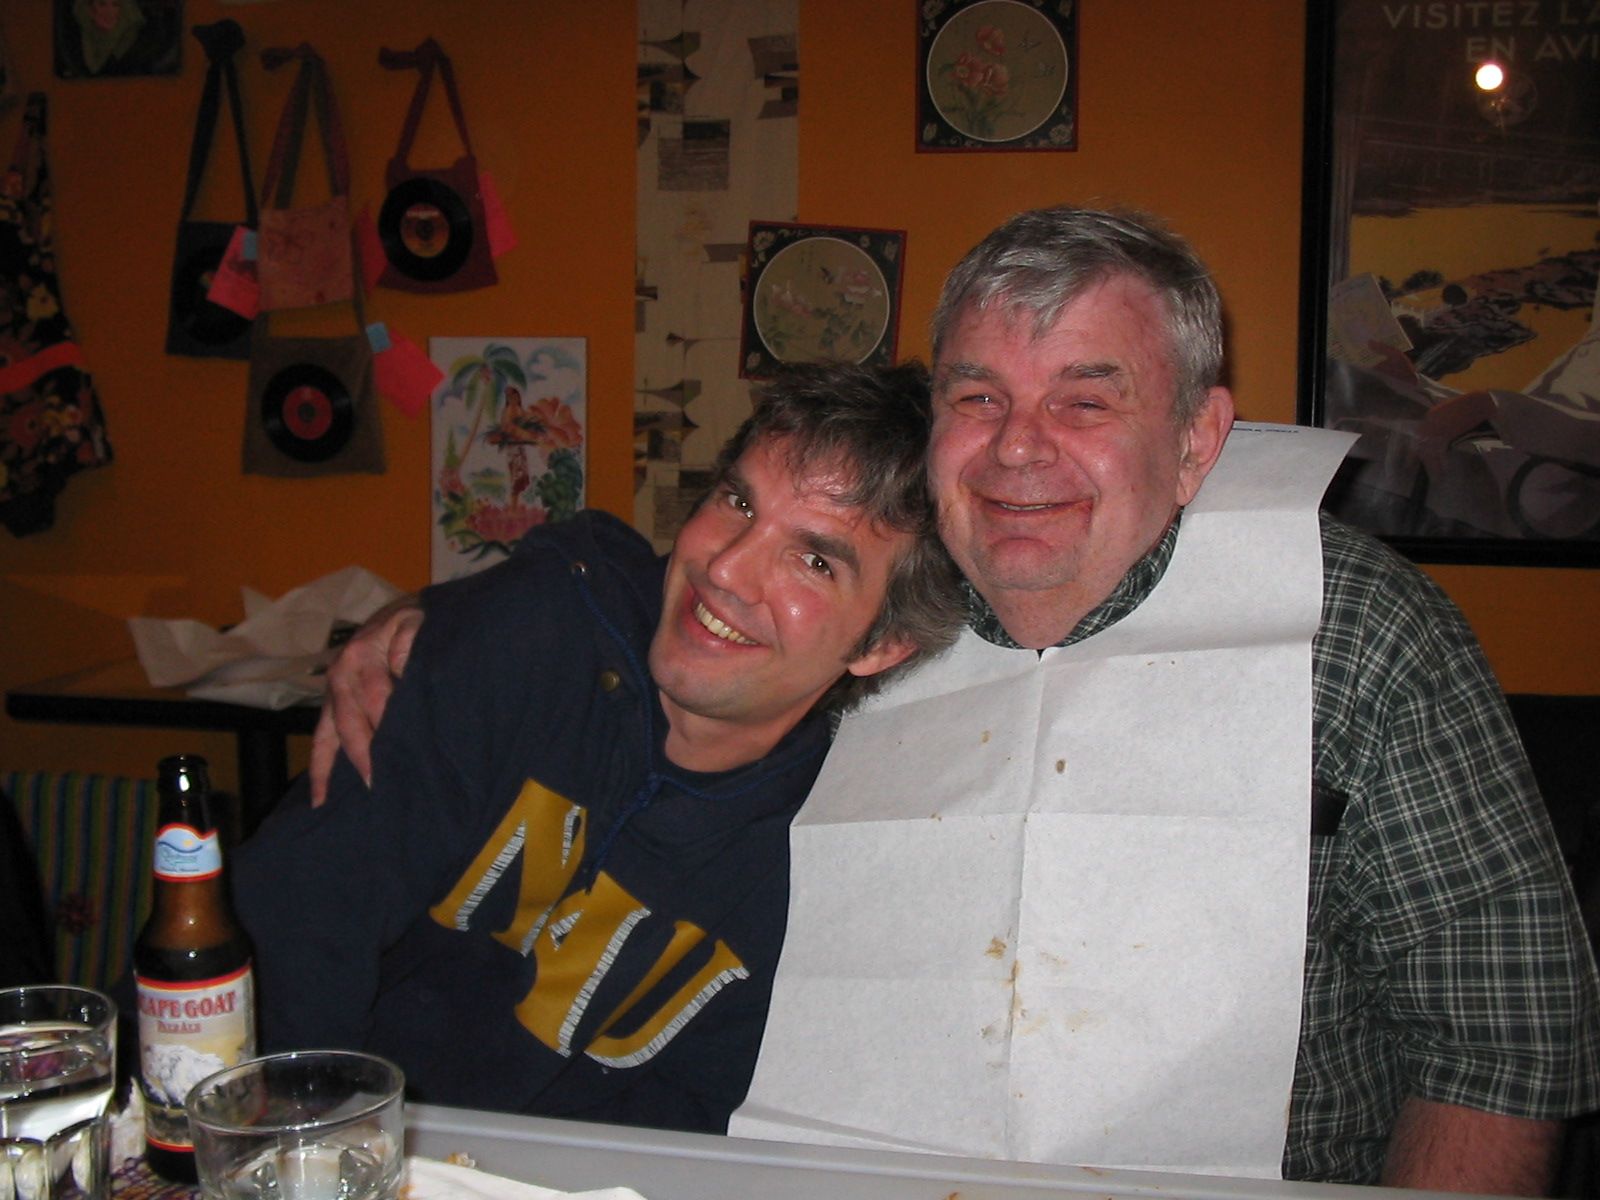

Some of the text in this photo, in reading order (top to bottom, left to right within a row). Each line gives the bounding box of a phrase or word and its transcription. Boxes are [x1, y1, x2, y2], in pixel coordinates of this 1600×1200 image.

[1383, 2, 1539, 28] VISITEZ
[1466, 33, 1600, 62] EN AVI
[185, 990, 236, 1018] GOAT
